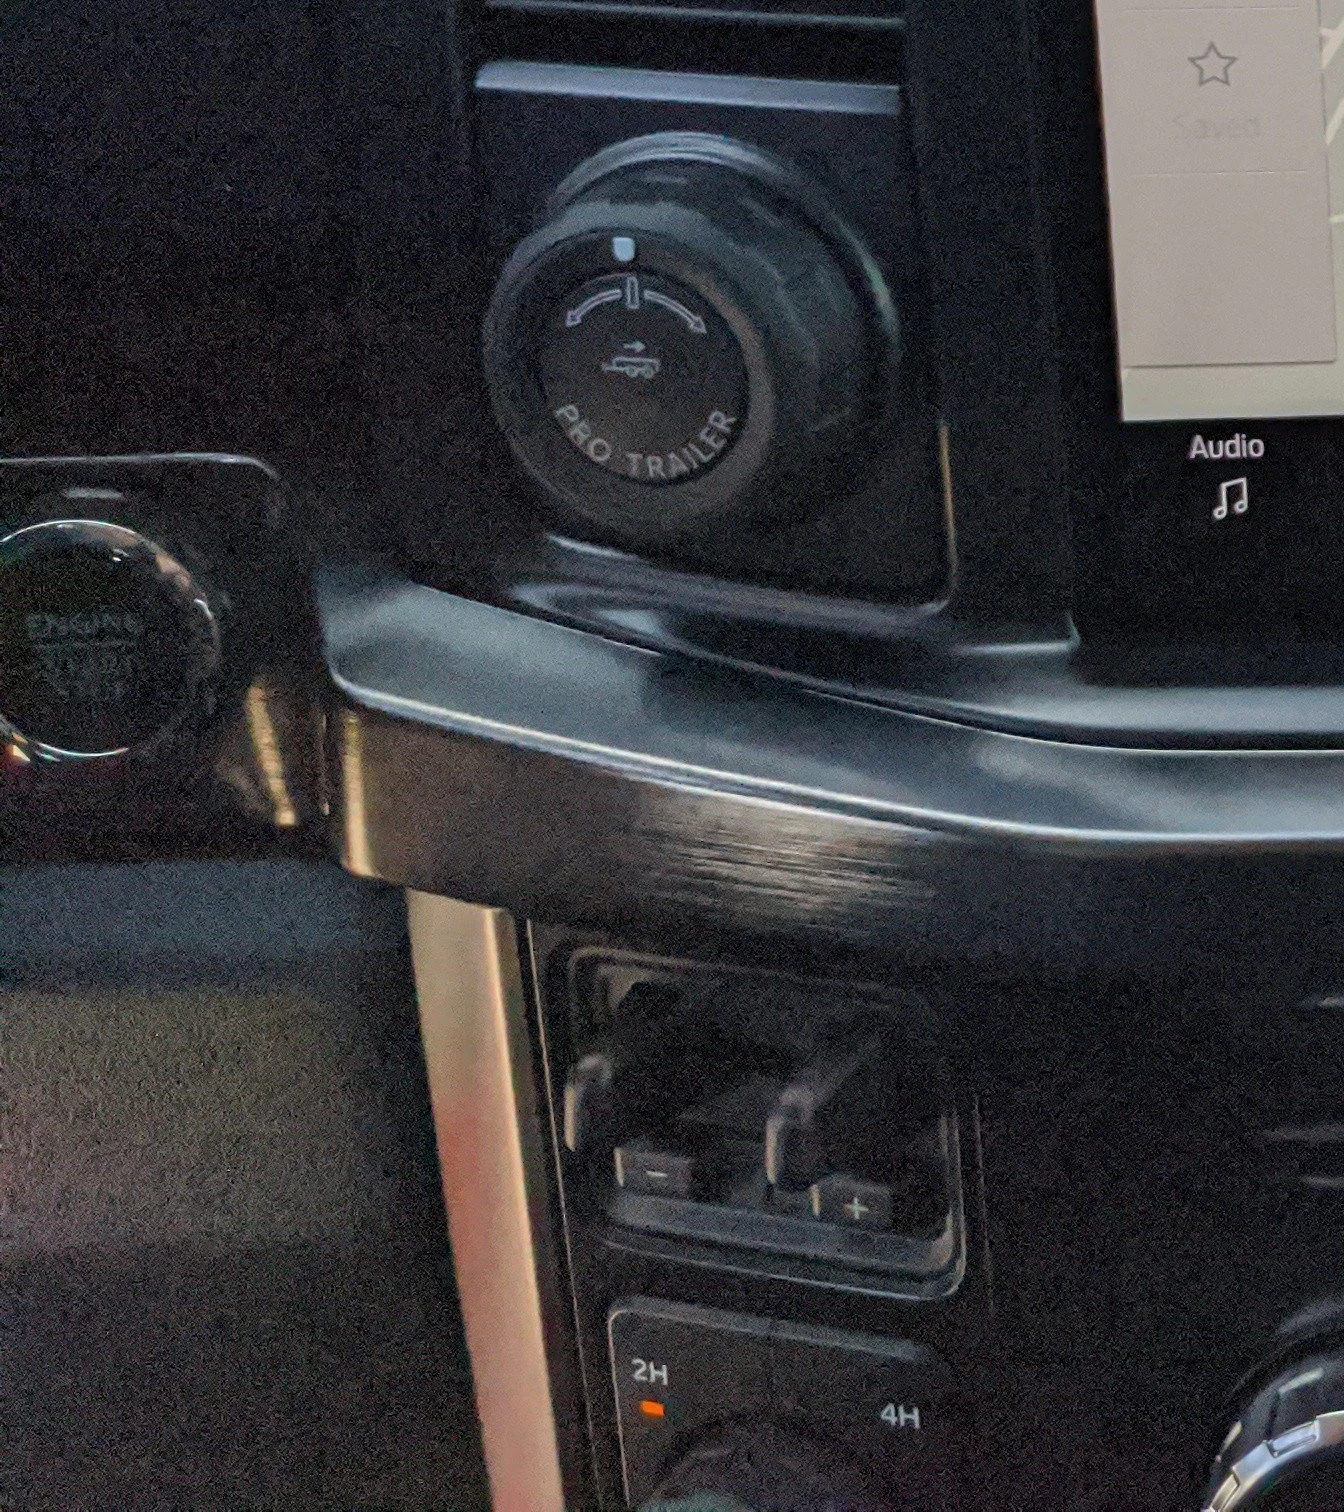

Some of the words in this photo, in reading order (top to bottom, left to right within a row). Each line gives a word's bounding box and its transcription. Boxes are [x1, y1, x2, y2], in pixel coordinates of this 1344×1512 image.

[554, 404, 613, 463] PRO
[626, 409, 738, 480] TRAILER
[1188, 433, 1266, 460] Audio
[632, 1358, 669, 1386] 2H
[880, 1401, 921, 1430] 4H
